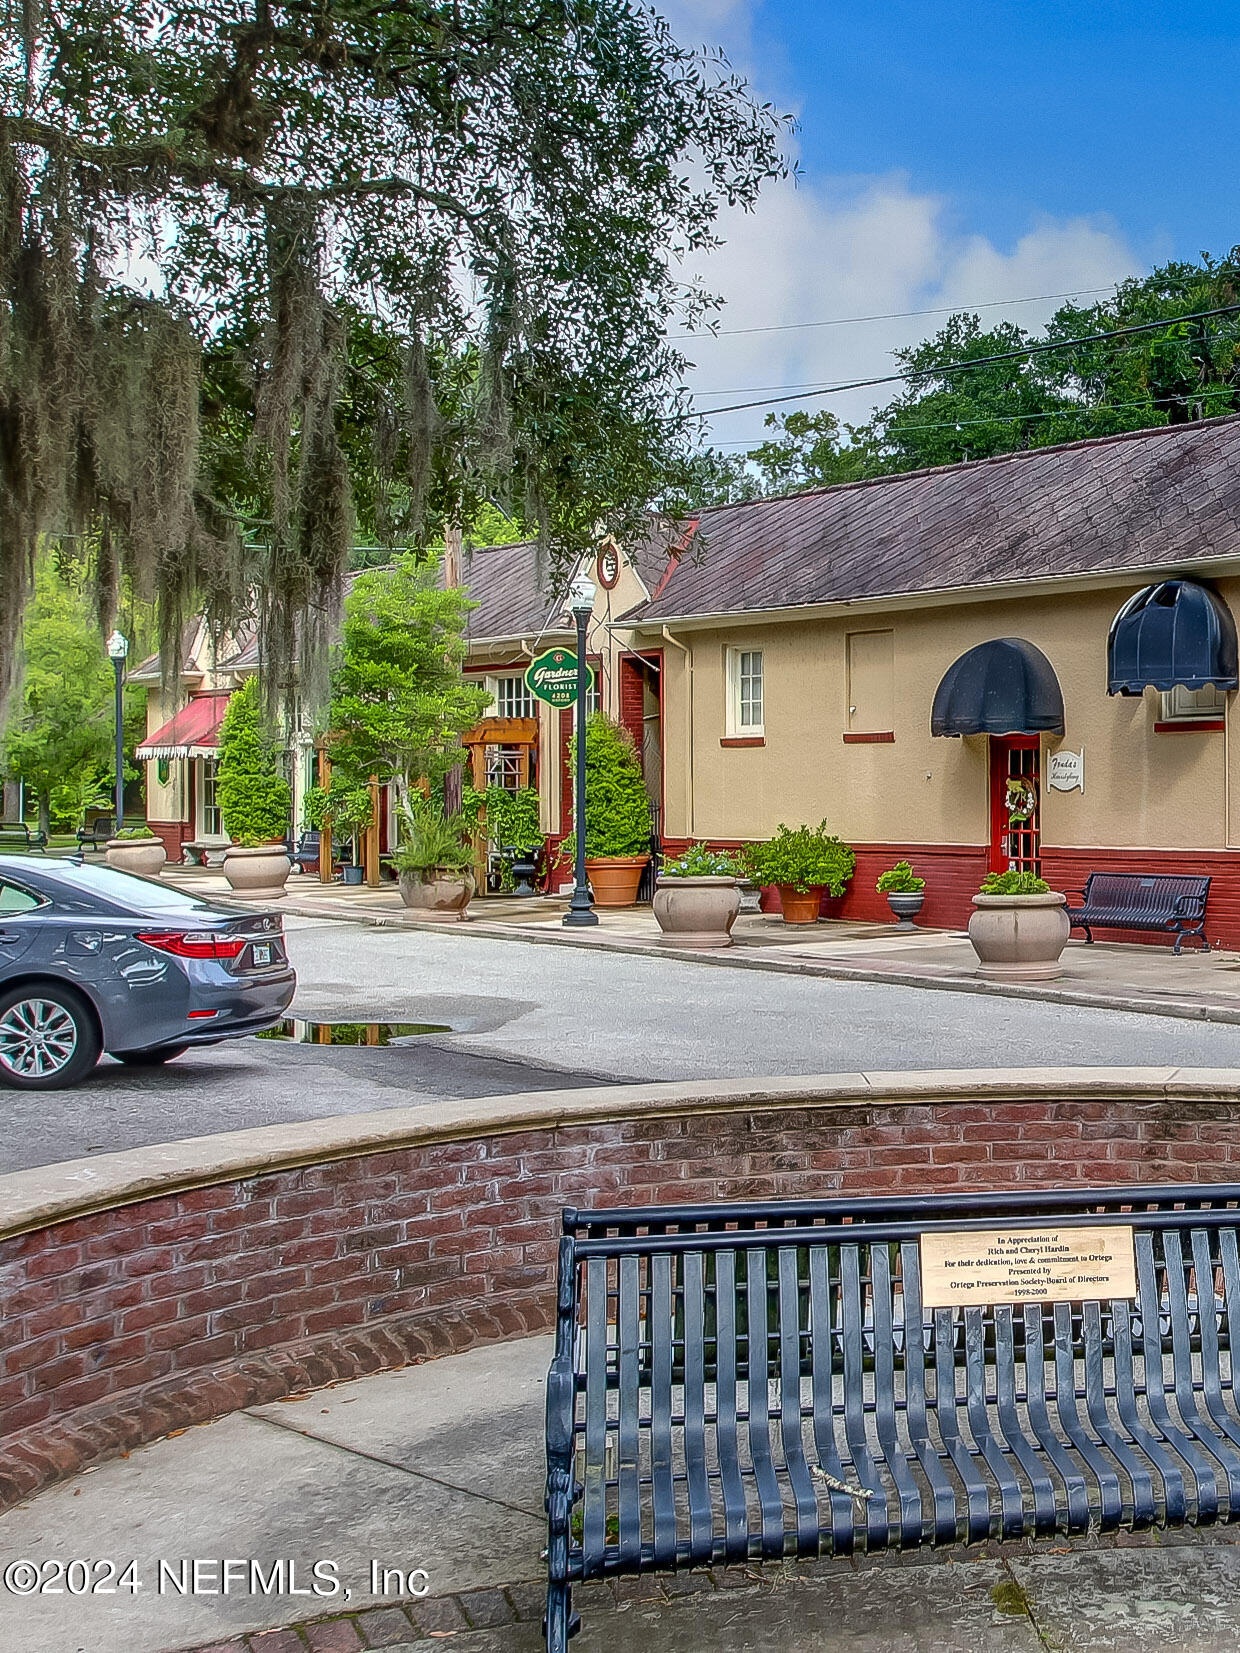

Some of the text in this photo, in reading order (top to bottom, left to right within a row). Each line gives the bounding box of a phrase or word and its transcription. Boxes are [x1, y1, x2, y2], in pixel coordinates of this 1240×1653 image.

[1006, 1235, 1050, 1245] Appreciation
[1005, 1247, 1019, 1255] and
[1019, 1246, 1043, 1255] Cheryl
[1044, 1245, 1070, 1253] Hardin
[975, 1258, 1013, 1266] dedication,
[1037, 1255, 1079, 1263] commitment
[1088, 1254, 1112, 1262] Ortega
[1042, 1266, 1051, 1275] by
[950, 1281, 974, 1289] Ortega
[976, 1279, 1019, 1288] Preservation
